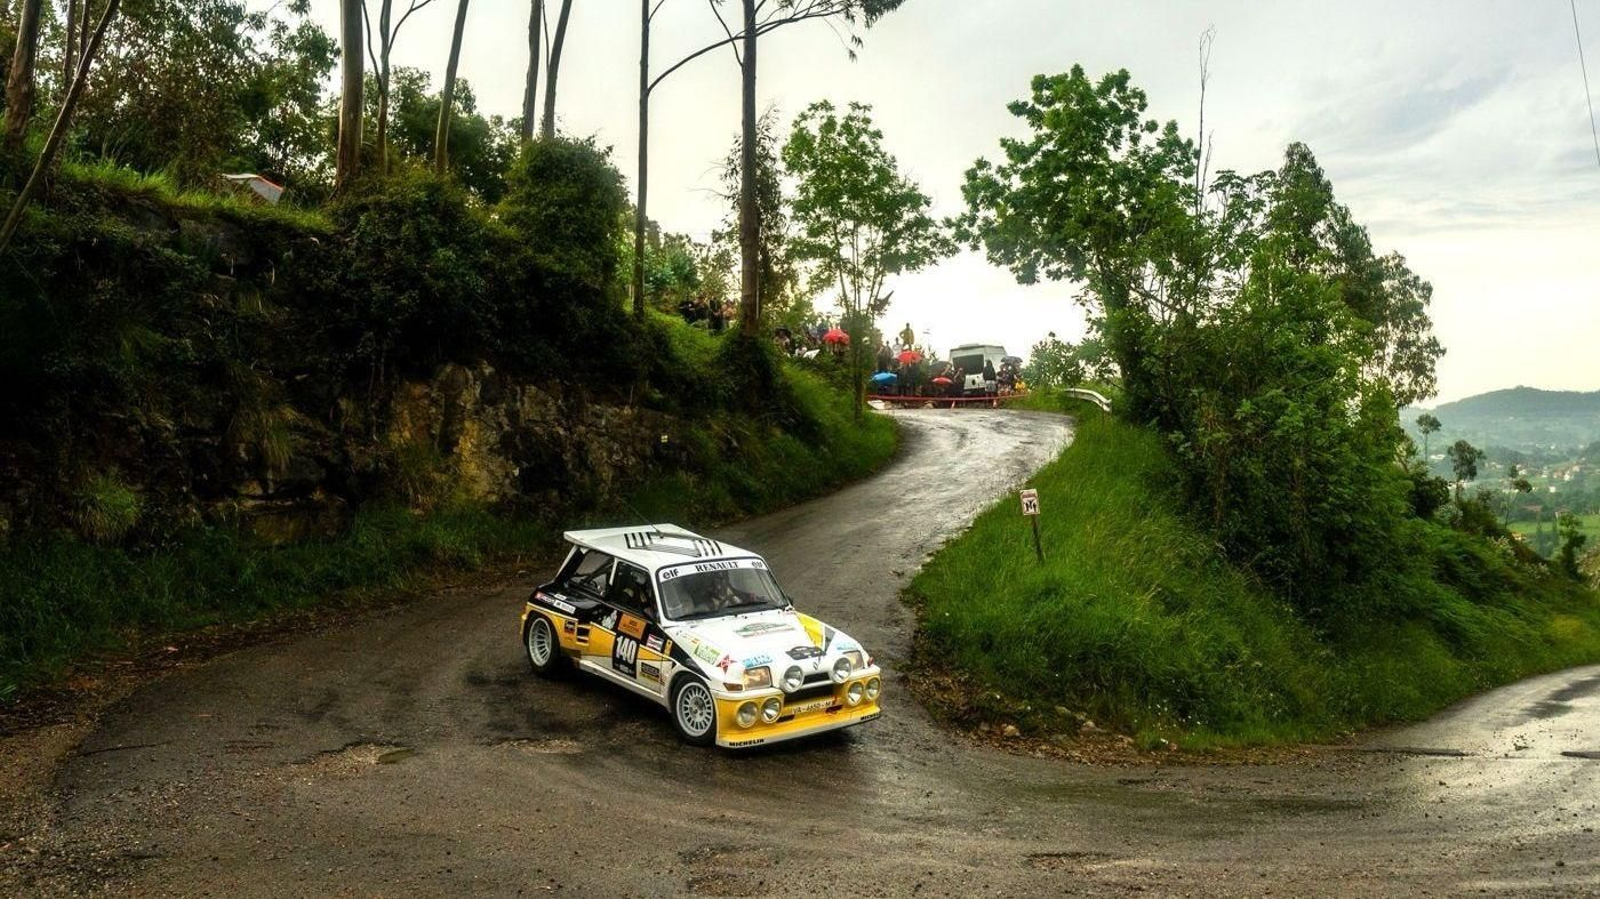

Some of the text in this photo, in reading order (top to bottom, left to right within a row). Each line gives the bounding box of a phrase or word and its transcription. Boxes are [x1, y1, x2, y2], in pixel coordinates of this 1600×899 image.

[663, 568, 680, 579] elf
[695, 561, 738, 572] RENAULT
[616, 635, 637, 664] 140
[729, 739, 764, 747] MICHELIN
